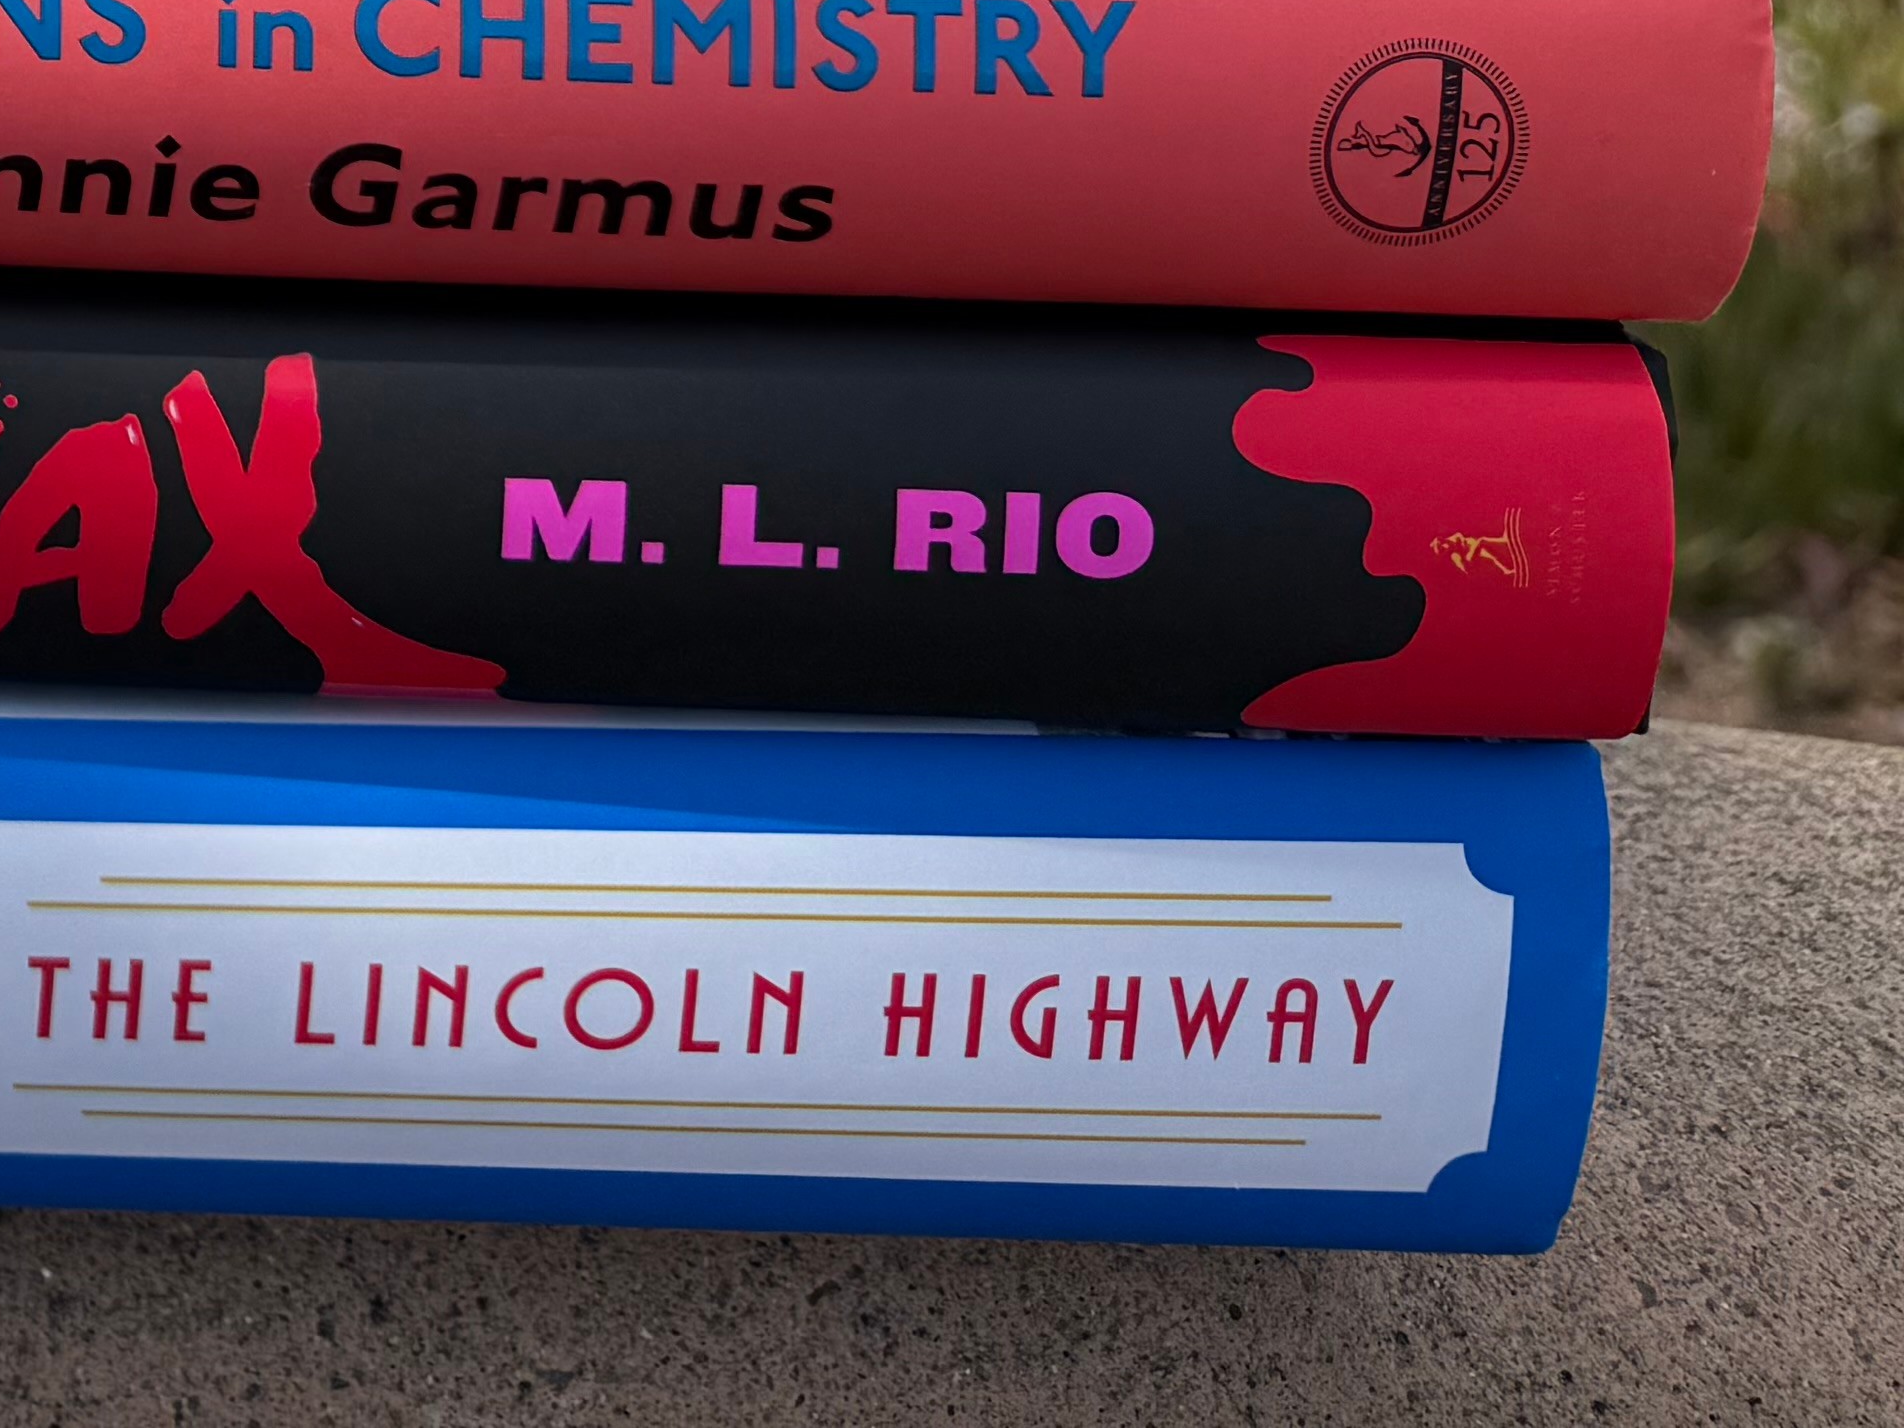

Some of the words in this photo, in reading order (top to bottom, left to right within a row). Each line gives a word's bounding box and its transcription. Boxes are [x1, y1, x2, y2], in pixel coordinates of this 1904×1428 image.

[306, 140, 838, 244] Garmus
[1456, 110, 1501, 183] 125
[500, 476, 665, 564] M.
[716, 483, 841, 572] L.
[892, 487, 1156, 580] RIO
[26, 953, 215, 1045] THE
[292, 959, 807, 1059] LINCOLN
[883, 973, 1397, 1068] HIGHWAY
